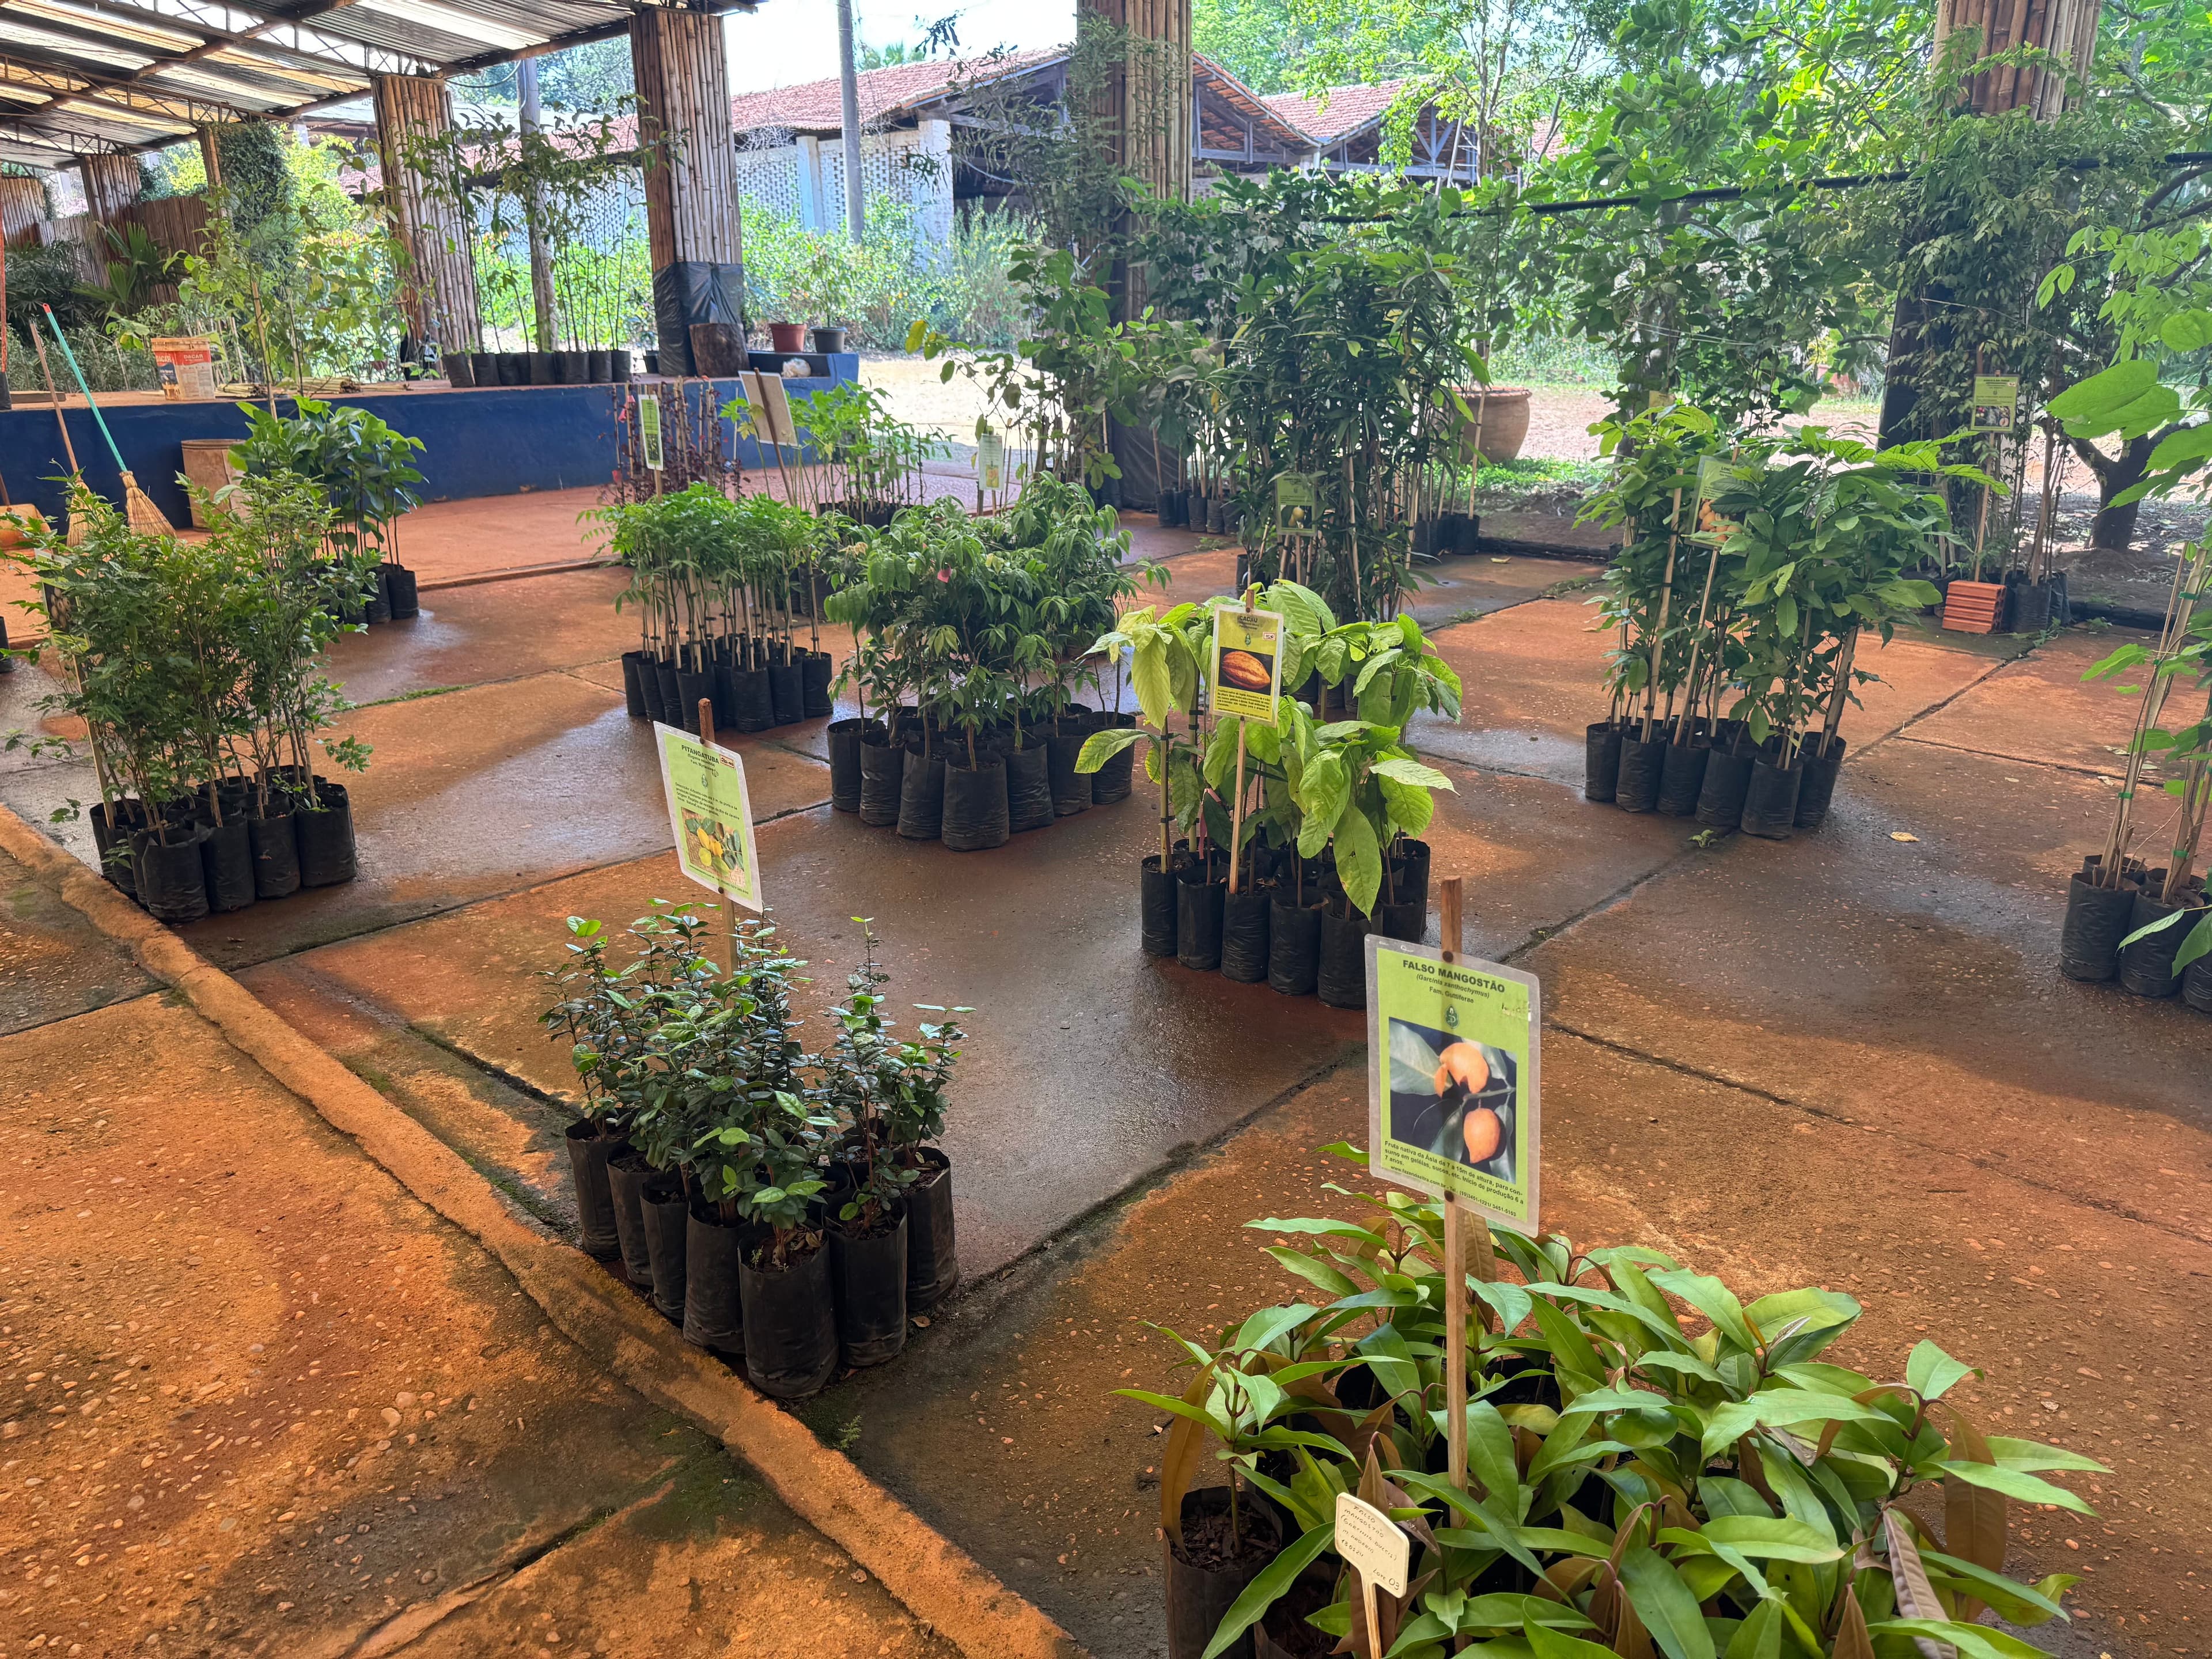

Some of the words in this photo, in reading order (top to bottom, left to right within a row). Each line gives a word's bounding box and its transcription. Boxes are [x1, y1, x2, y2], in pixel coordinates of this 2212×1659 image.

[681, 745, 719, 764] PITANGATUBA
[1403, 960, 1435, 974] FALSO
[1438, 968, 1505, 993] MANGOSTÃO
[1416, 974, 1443, 986] (Garcinia
[1444, 981, 1490, 999] xanthochymus)
[1429, 986, 1444, 995] Fam.
[1445, 991, 1474, 1003] Guttiferae
[1385, 1141, 1399, 1150] Fruta
[1400, 1146, 1416, 1156] nativa
[1425, 1153, 1437, 1163] Ásia
[1456, 1166, 1467, 1175] 15m
[1476, 1175, 1494, 1186] altura,
[1495, 1183, 1508, 1191] para
[1510, 1188, 1523, 1196] con-
[1389, 1157, 1404, 1166] anos.
[1385, 1149, 1400, 1157] sumo
[1410, 1157, 1431, 1169] geléias,
[1432, 1165, 1450, 1176] sucos,
[1452, 1172, 1461, 1180] etc.
[1462, 1176, 1477, 1187] Início
[1486, 1187, 1514, 1200] produção
[1353, 1505, 1376, 1523] FALSO
[1389, 1578, 1400, 1590] 03
